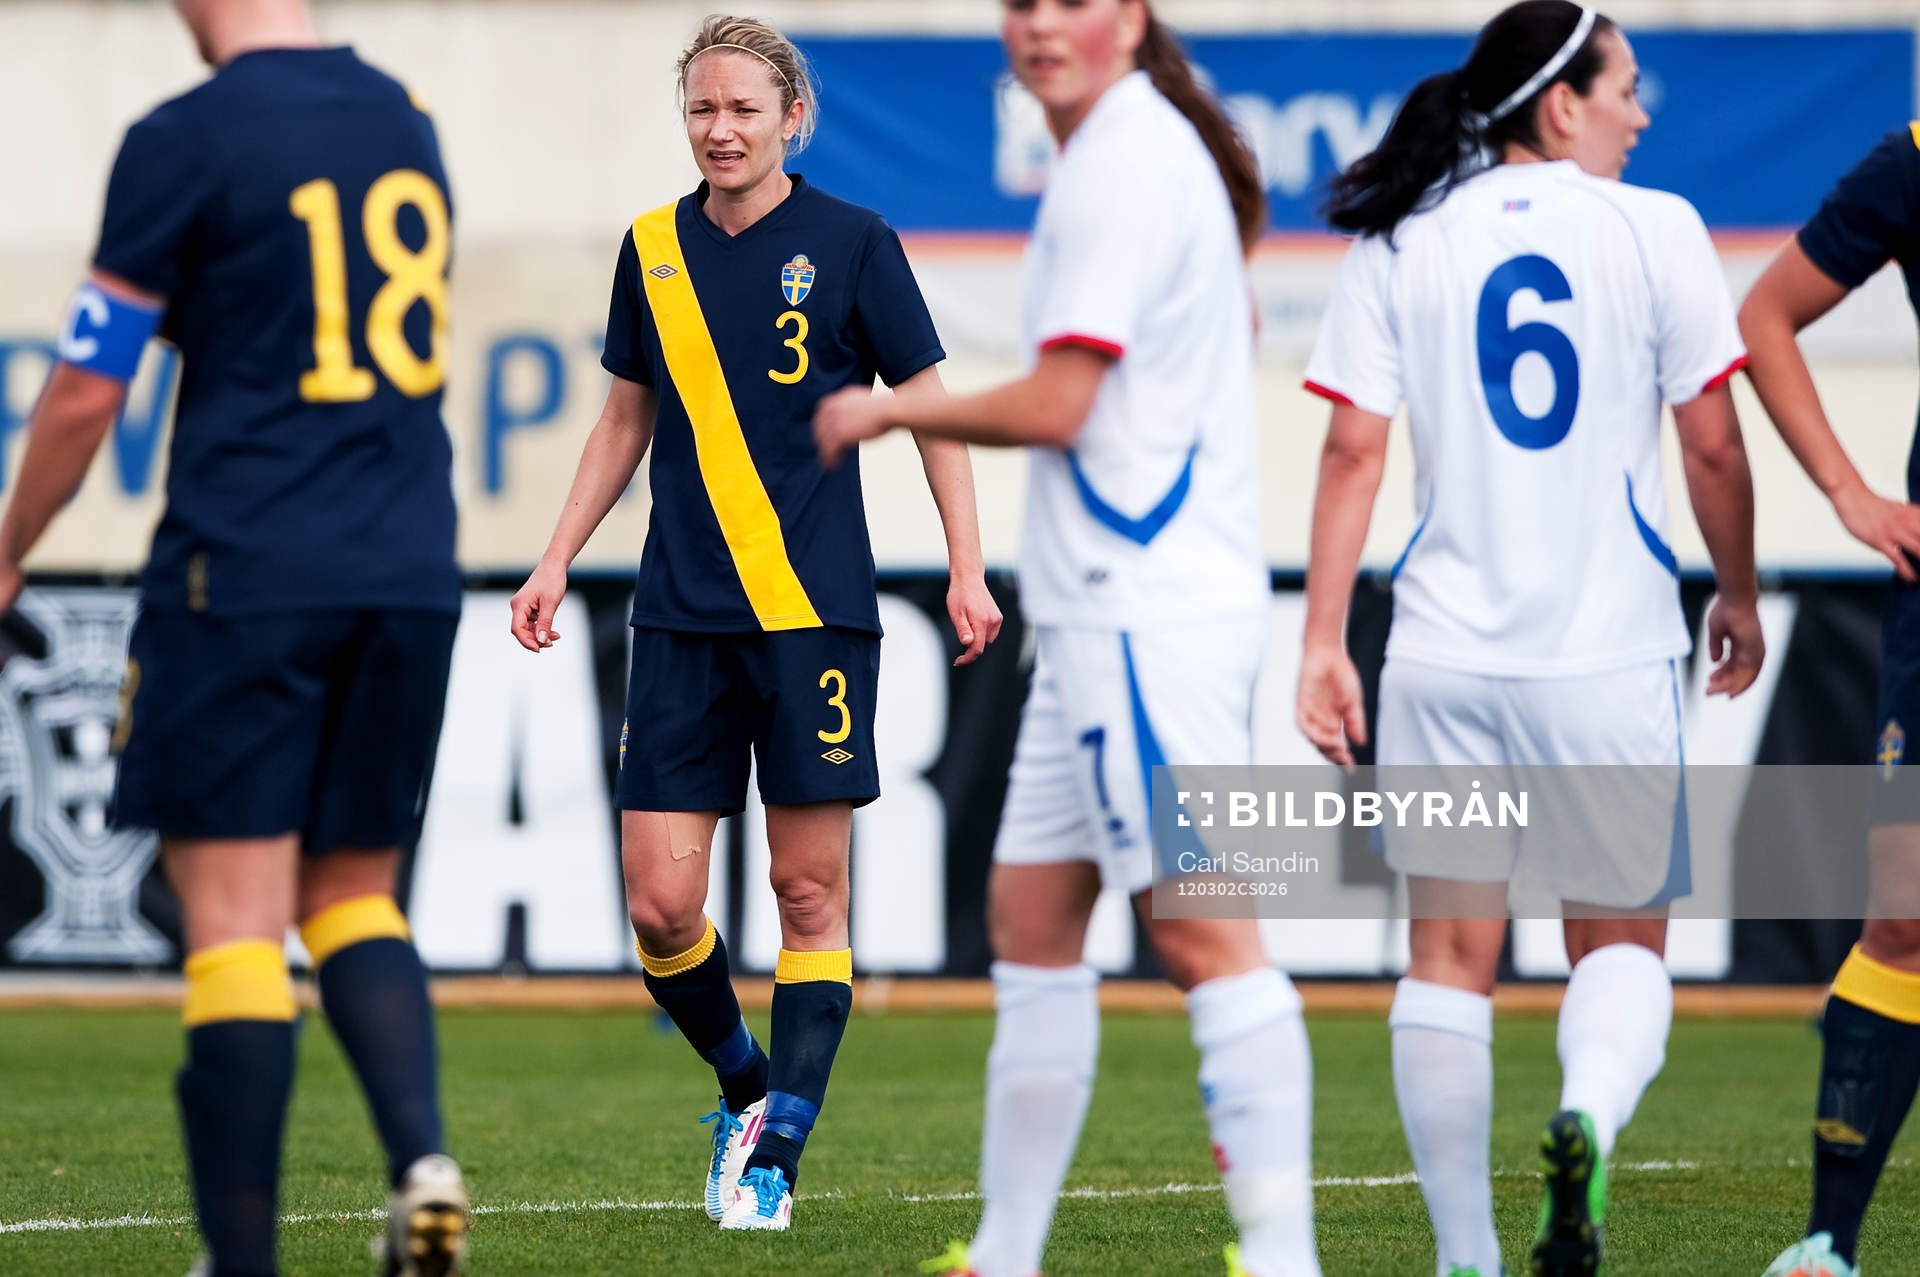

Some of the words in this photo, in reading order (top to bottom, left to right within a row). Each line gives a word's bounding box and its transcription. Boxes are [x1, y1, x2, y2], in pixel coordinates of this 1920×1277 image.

[58, 286, 110, 360] C
[289, 168, 448, 402] 18
[768, 310, 809, 385] 3
[1477, 254, 1579, 450] 6
[817, 668, 851, 744] 3
